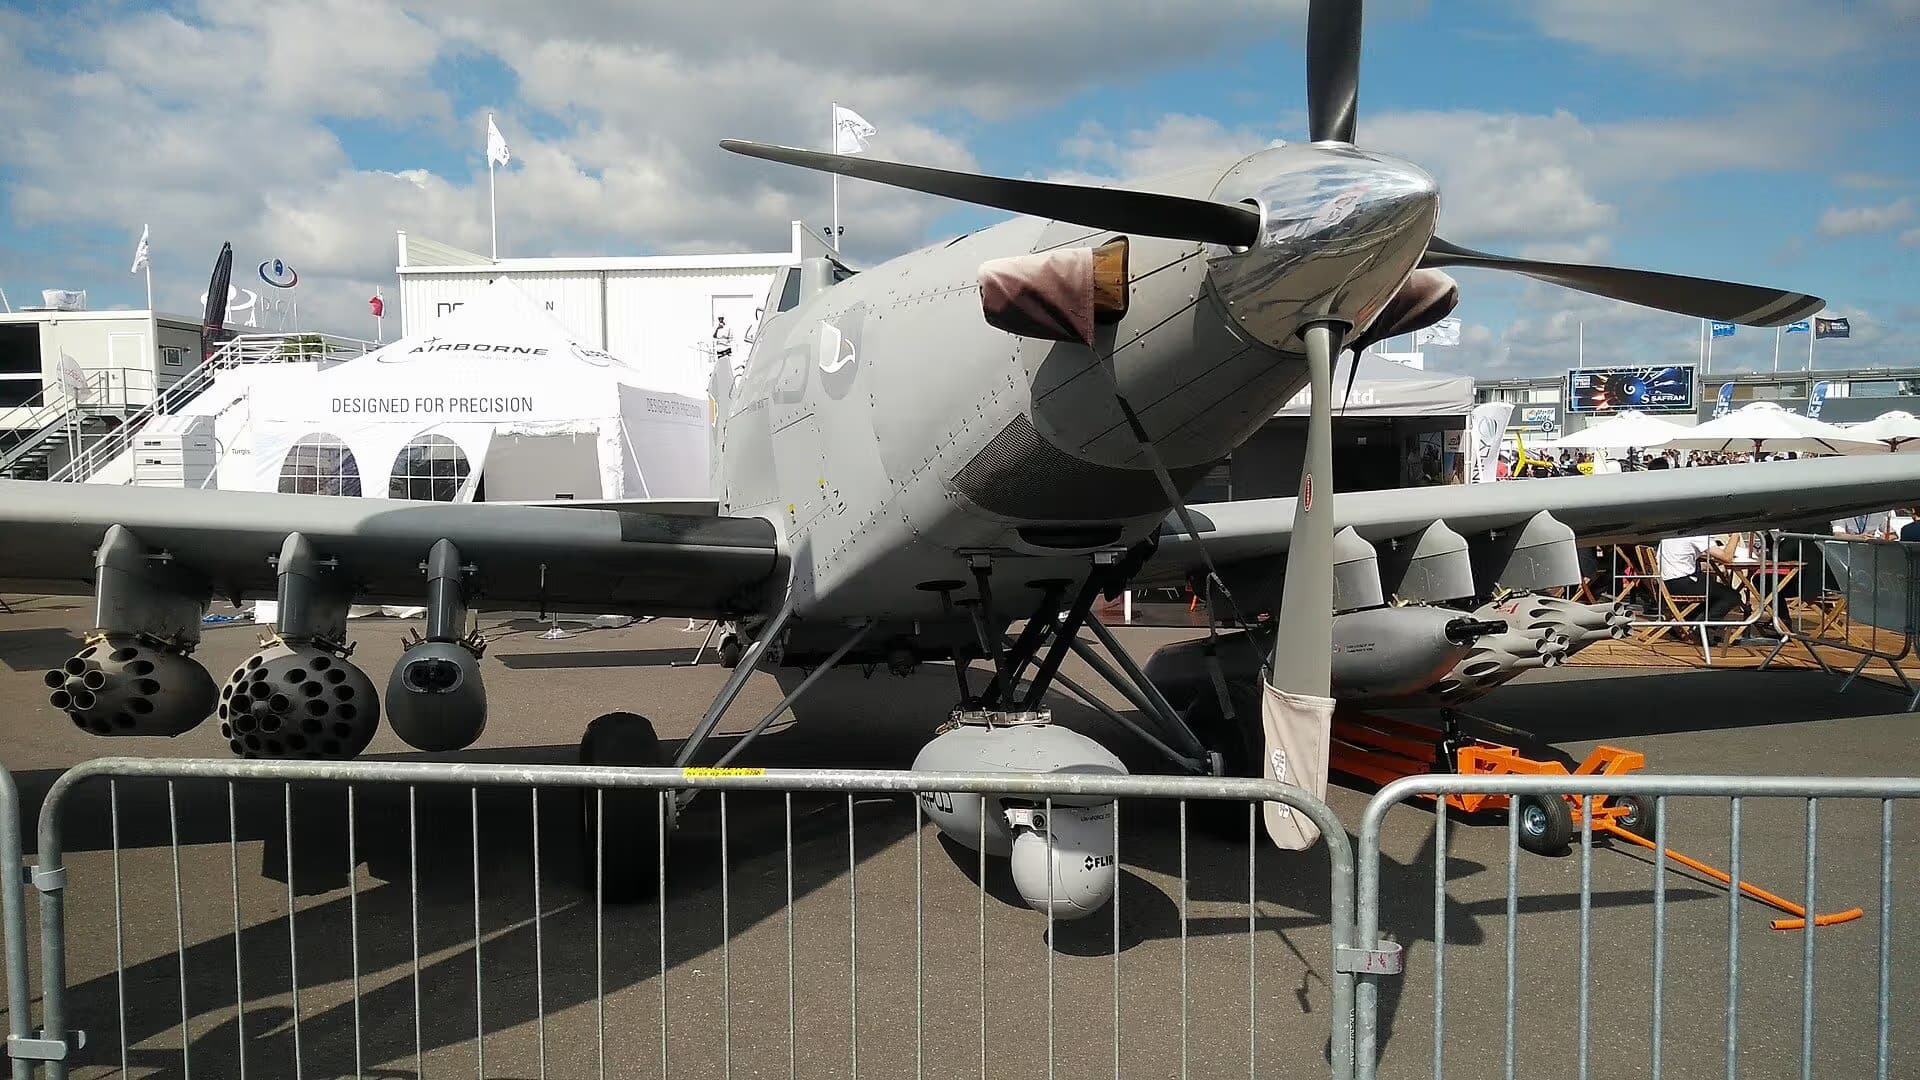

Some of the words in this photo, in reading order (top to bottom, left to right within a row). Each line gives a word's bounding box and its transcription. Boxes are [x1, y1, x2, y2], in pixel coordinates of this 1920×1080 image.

[409, 343, 549, 356] AIRBORNE
[332, 398, 410, 413] DESIGNED
[415, 398, 444, 413] FOR
[450, 397, 533, 413] PRECISION
[1095, 855, 1115, 869] FLIR
